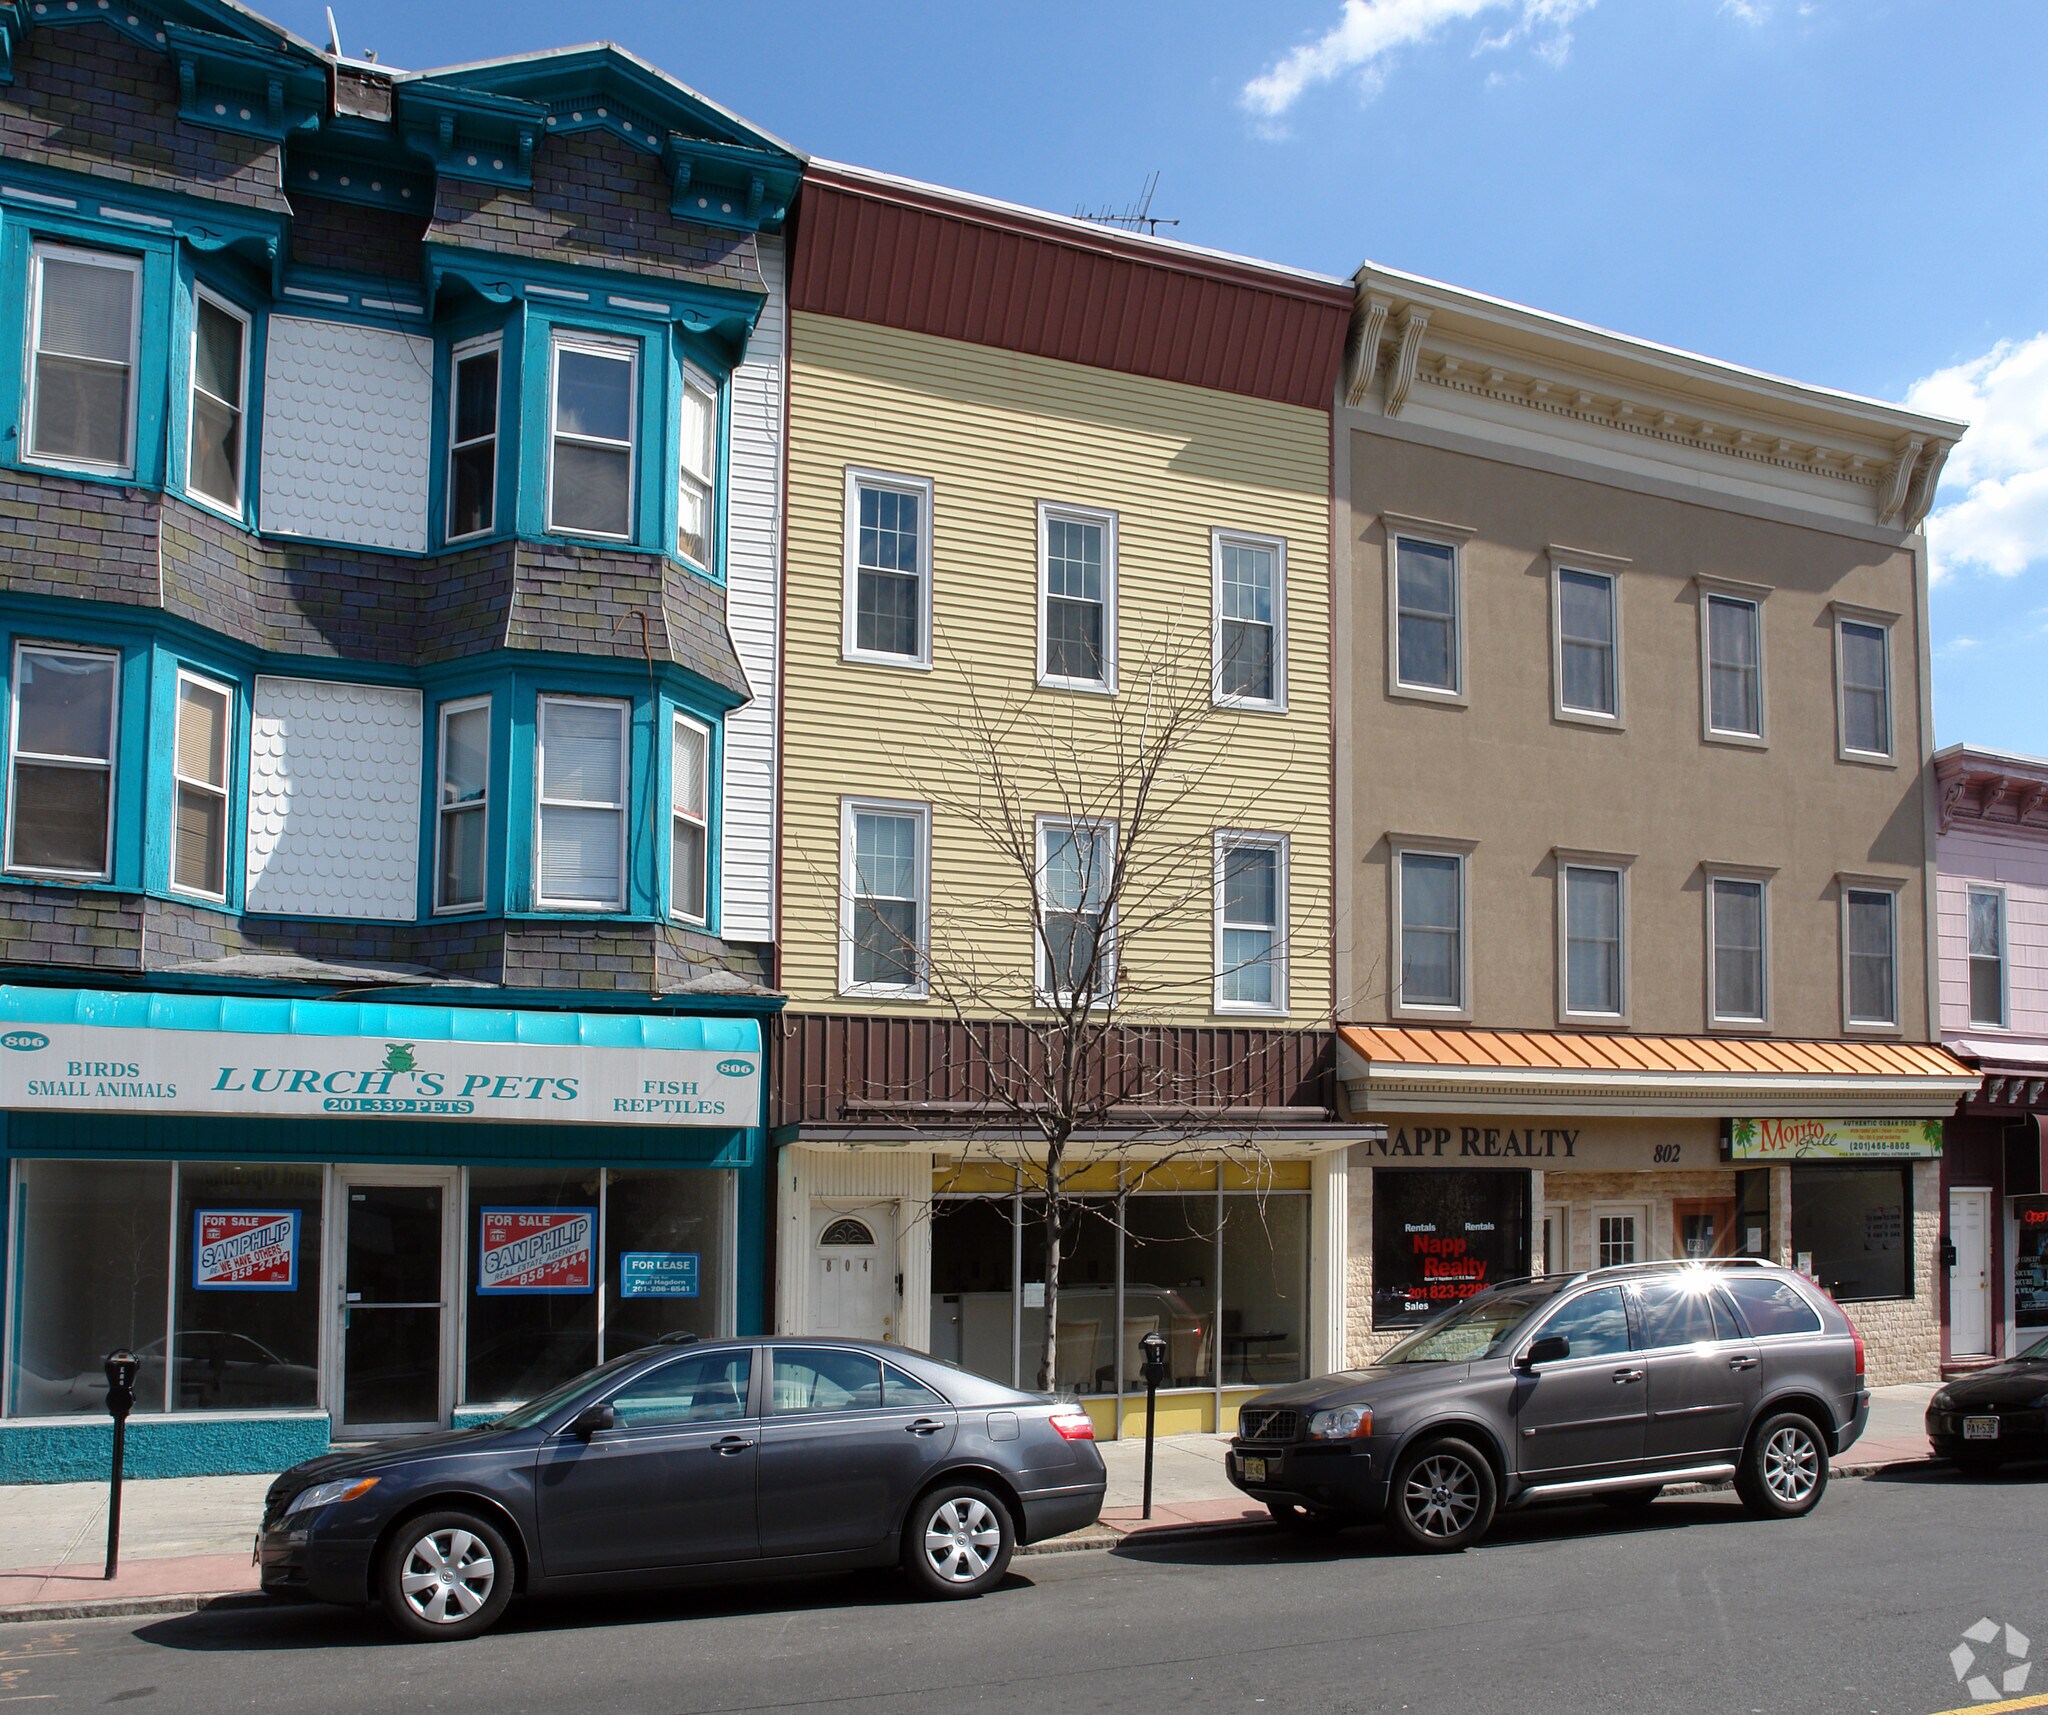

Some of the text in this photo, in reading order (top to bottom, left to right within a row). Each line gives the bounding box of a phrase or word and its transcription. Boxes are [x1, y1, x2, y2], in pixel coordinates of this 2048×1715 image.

[5, 1036, 45, 1047] 806
[67, 1061, 140, 1078] BIRDS
[719, 1063, 751, 1074] 806
[28, 1080, 177, 1099] SMALL ANIMALS
[457, 1074, 579, 1101] PETS
[643, 1080, 699, 1096] FISH
[328, 1099, 470, 1113] 201-339-PETS
[613, 1098, 726, 1115] REPTILES
[1366, 1127, 1580, 1158] NAPP REALTY
[1760, 1118, 1825, 1152] Mojito
[1653, 1144, 1681, 1164] 802
[204, 1216, 259, 1226] FOR SALE
[487, 1216, 551, 1226] FOR SALE
[2025, 1210, 2048, 1225] Open
[1405, 1223, 1436, 1232] Rentals
[1465, 1221, 1495, 1231] Rentals
[1413, 1234, 1467, 1257] Napp
[219, 1260, 232, 1272] WE
[233, 1253, 253, 1269] HAVE
[254, 1244, 282, 1261] OTHERS
[231, 1251, 289, 1281] 858-2444
[494, 1243, 580, 1281] REAL ESTATE AGENCY
[632, 1261, 690, 1270] FOR LEASE
[826, 1259, 868, 1272] 804
[519, 1251, 587, 1285] 858-2444
[1424, 1256, 1487, 1280] Realty
[1408, 1287, 1427, 1299] 201
[1405, 1302, 1429, 1311] Sales
